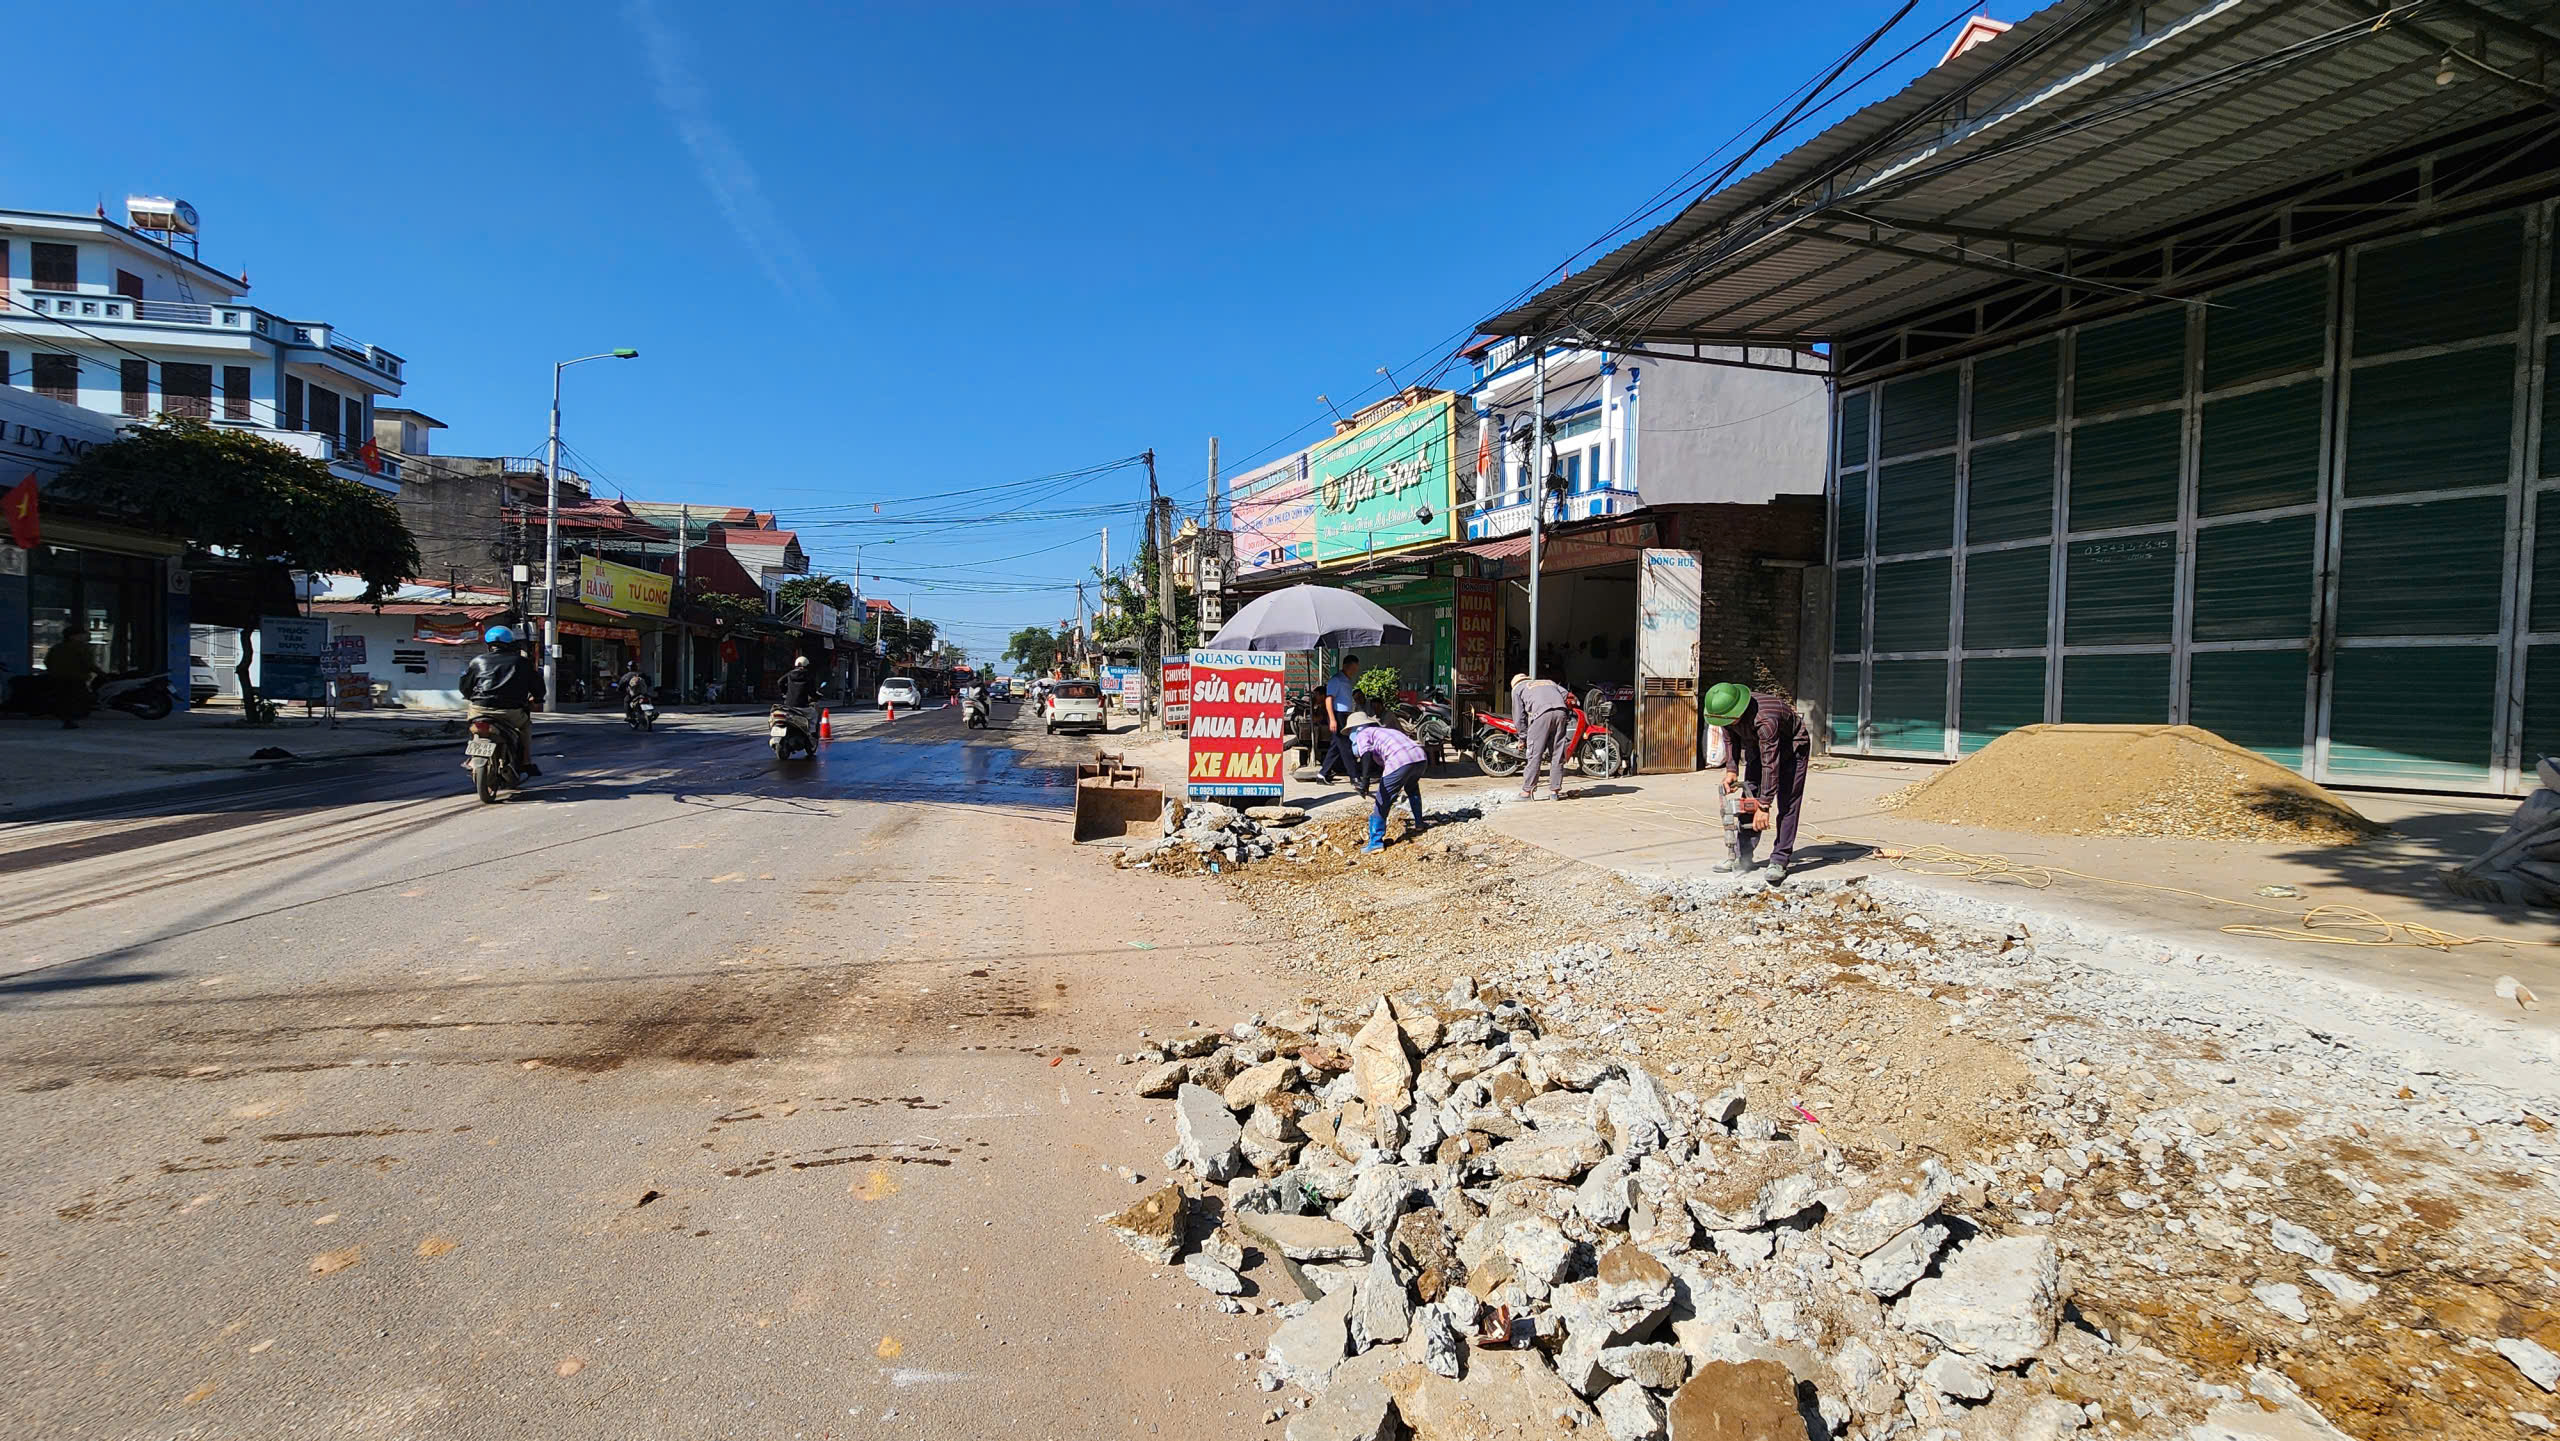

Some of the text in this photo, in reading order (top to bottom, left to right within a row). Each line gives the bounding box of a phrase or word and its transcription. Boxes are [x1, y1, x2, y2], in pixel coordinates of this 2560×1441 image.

[16, 424, 52, 450] LY
[1342, 462, 1421, 514] Yên Spa
[586, 577, 598, 596] HÀ
[599, 581, 614, 602] NỘI
[643, 587, 668, 605] LONG
[1461, 595, 1492, 612] MUA
[1462, 614, 1491, 632] BÁN
[1468, 637, 1486, 652] XE
[1194, 653, 1243, 664] QUANG
[1248, 655, 1282, 665] VINH
[1461, 654, 1491, 676] MÁY
[1193, 673, 1282, 703] SỬA CHỮA
[1191, 712, 1283, 739] MUA BÁN
[1190, 745, 1282, 778] XE MÁY
